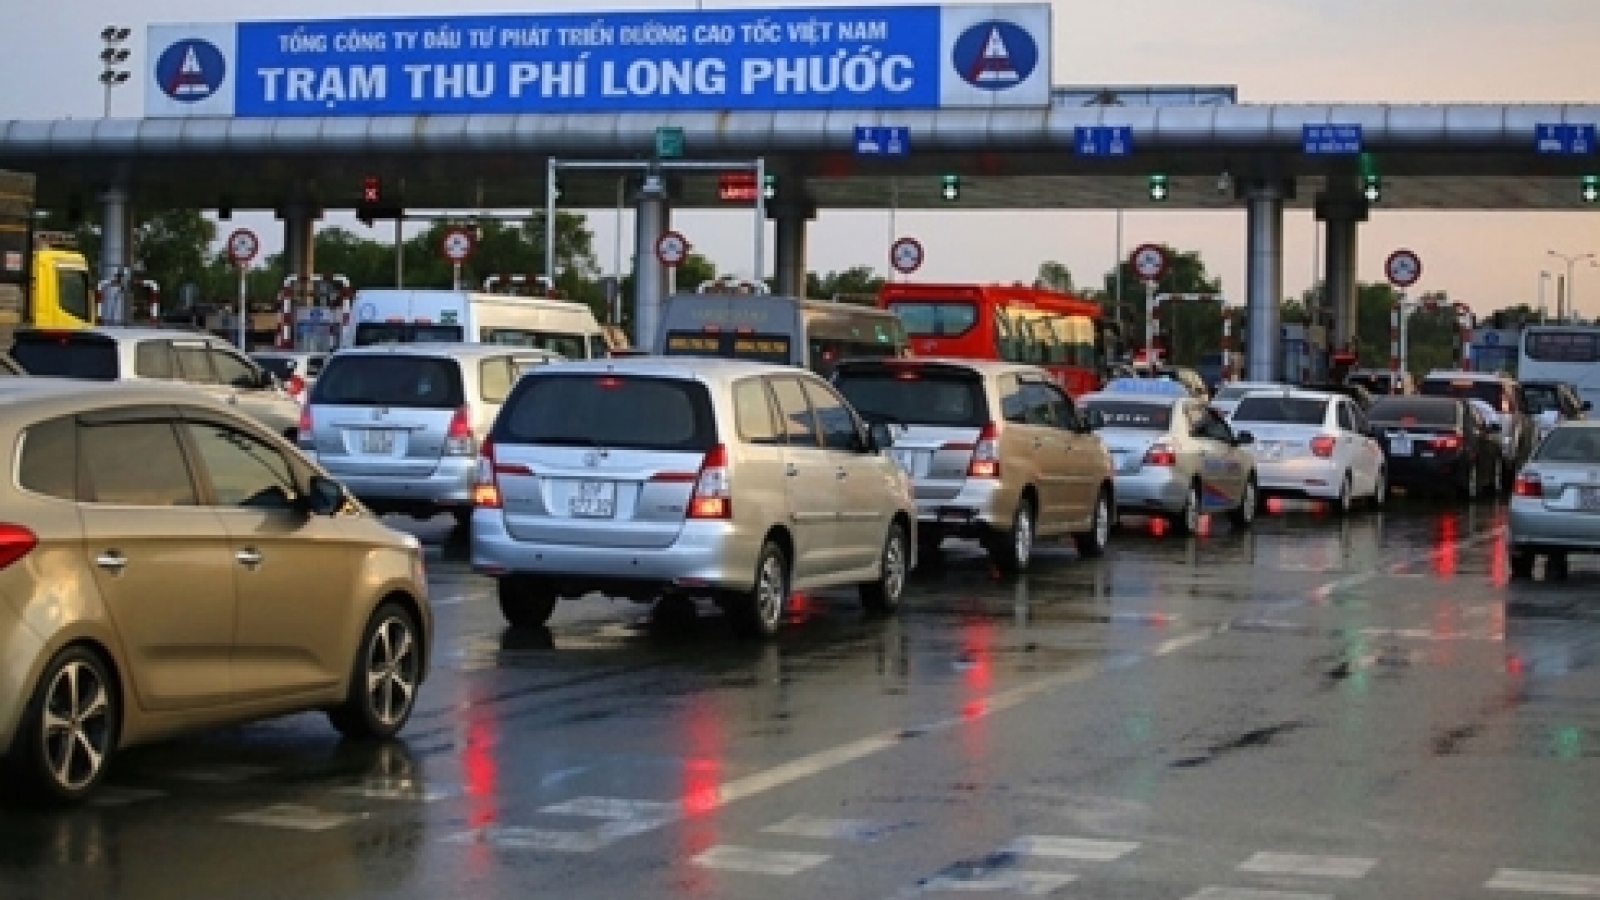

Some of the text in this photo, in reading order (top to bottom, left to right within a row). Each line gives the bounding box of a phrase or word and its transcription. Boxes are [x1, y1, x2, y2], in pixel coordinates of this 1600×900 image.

[333, 29, 386, 52] CÔNG
[392, 31, 418, 49] TY
[467, 25, 496, 48] TƯ
[500, 22, 552, 48] PHÁT
[692, 22, 735, 45] CAO
[740, 16, 781, 45] TỐC
[786, 16, 833, 46] VIỆT
[838, 21, 888, 42] NAM
[257, 45, 915, 108] TRẠM THU PHÍ LONG PHƯỚC
